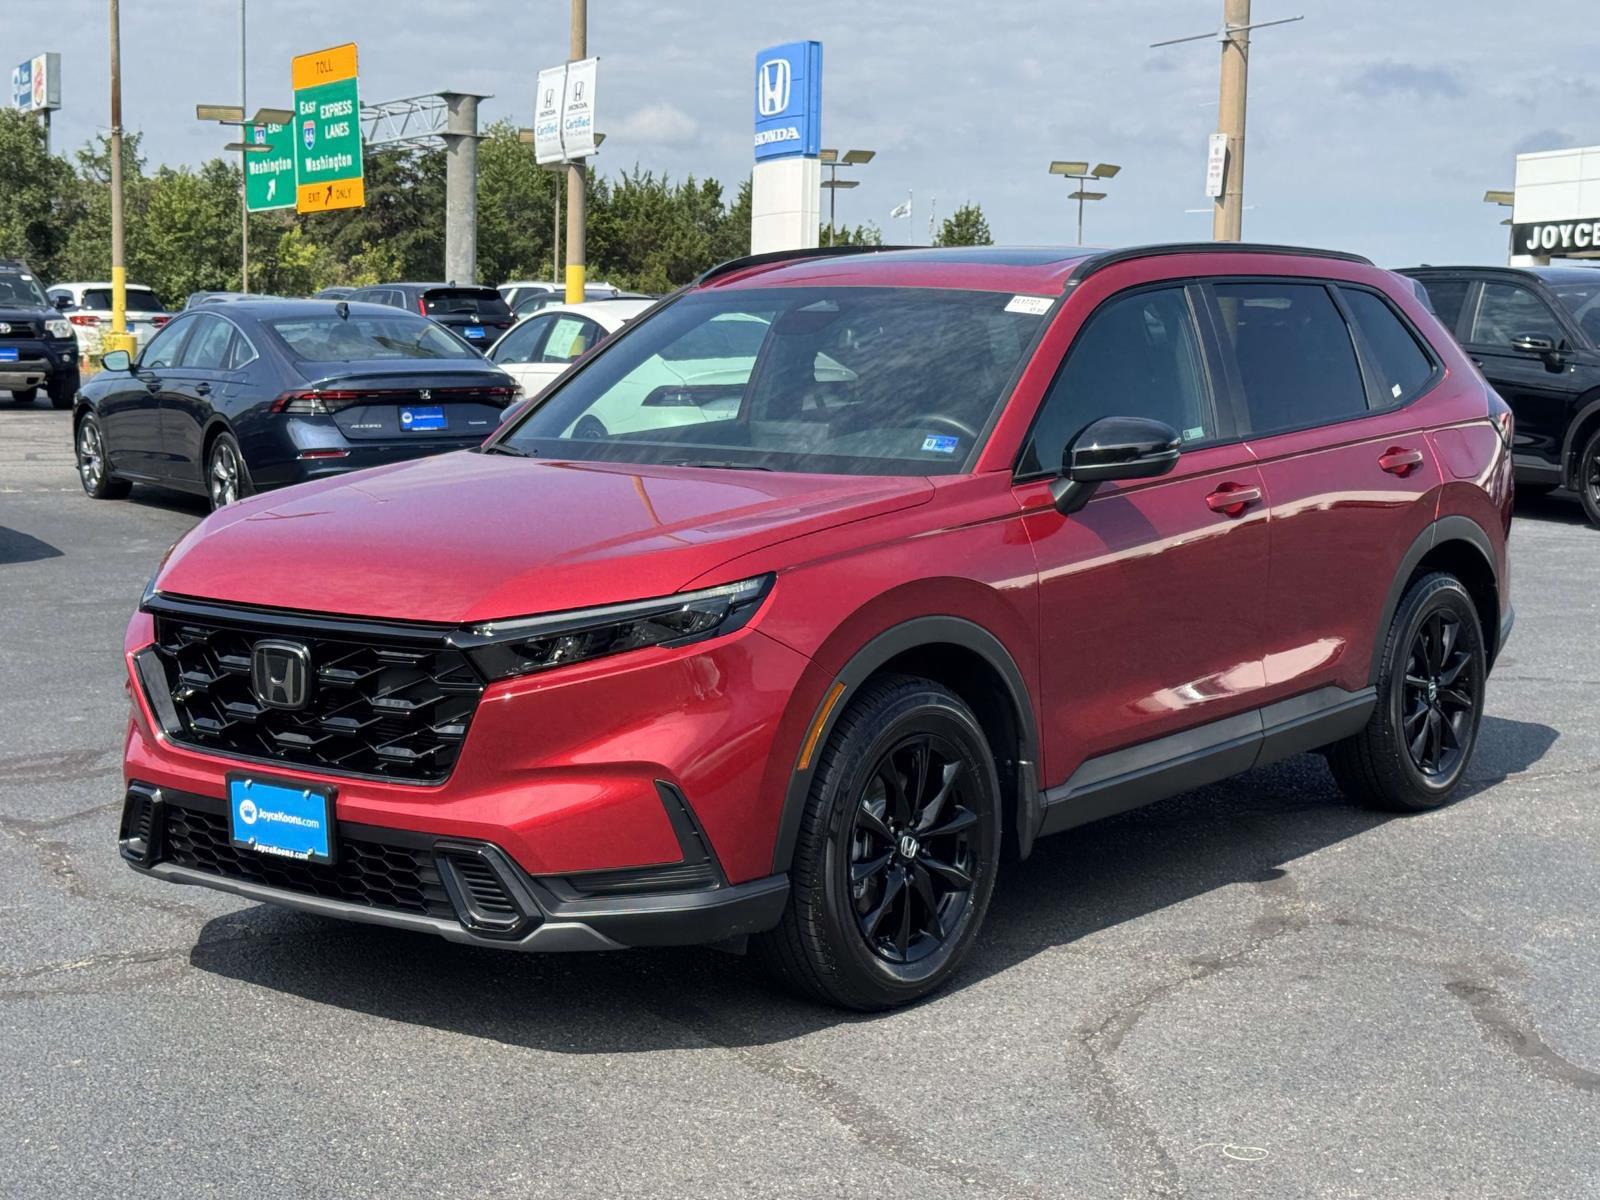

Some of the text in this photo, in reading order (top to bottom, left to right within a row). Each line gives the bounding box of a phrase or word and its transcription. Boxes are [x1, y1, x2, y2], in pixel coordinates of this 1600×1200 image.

[316, 60, 333, 74] TOLL
[300, 101, 316, 115] EAST
[320, 100, 352, 119] EXPRESS
[325, 122, 349, 139] LANES
[755, 126, 800, 146] HONDA
[249, 158, 292, 175] Washington
[305, 153, 352, 172] Washington
[308, 188, 351, 203] EXIT ONLY
[1526, 222, 1600, 250] JOYCE
[258, 808, 320, 829] JoyceKoons.com
[253, 842, 310, 860] JoyceKoons.com
